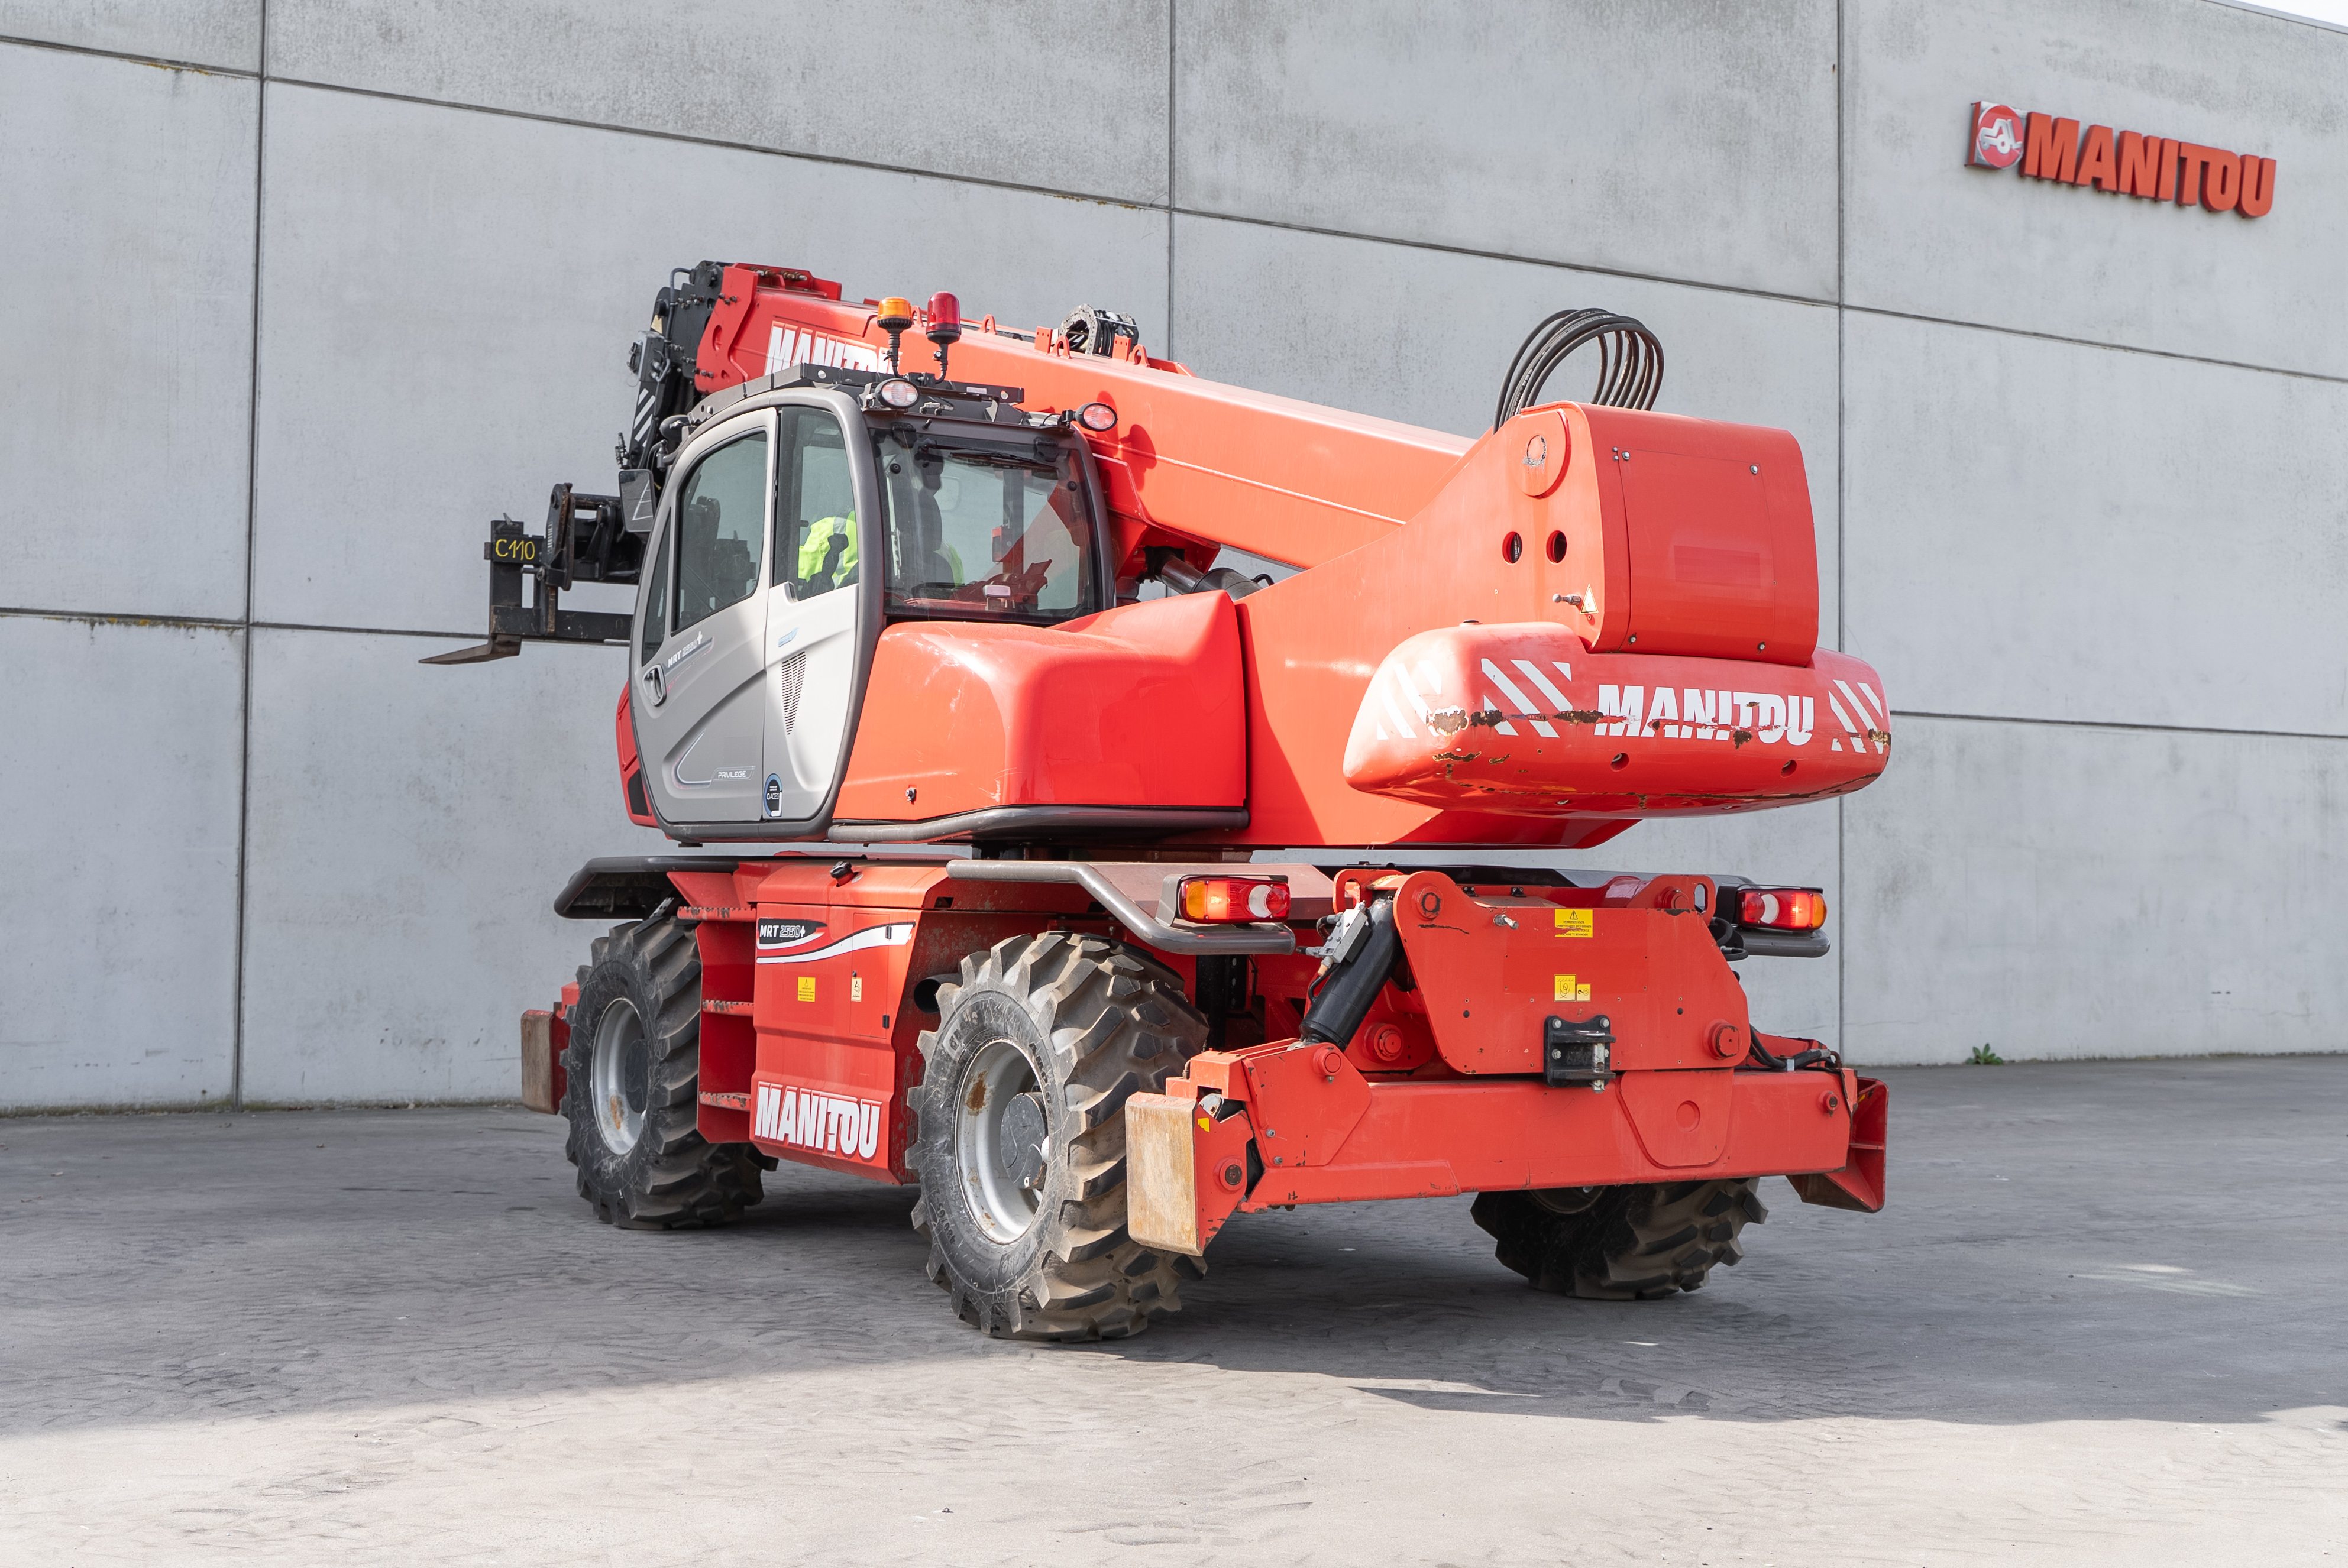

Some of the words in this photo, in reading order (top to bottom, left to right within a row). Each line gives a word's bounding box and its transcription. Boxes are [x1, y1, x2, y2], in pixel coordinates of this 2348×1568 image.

[2019, 112, 2276, 218] MANITOU
[496, 539, 535, 561] C110
[668, 650, 682, 668] MRT
[1594, 684, 1815, 746] MANITOU
[717, 770, 746, 779] PRIVILEGE
[759, 925, 780, 938] MRT
[755, 1083, 882, 1159] MANITOU
